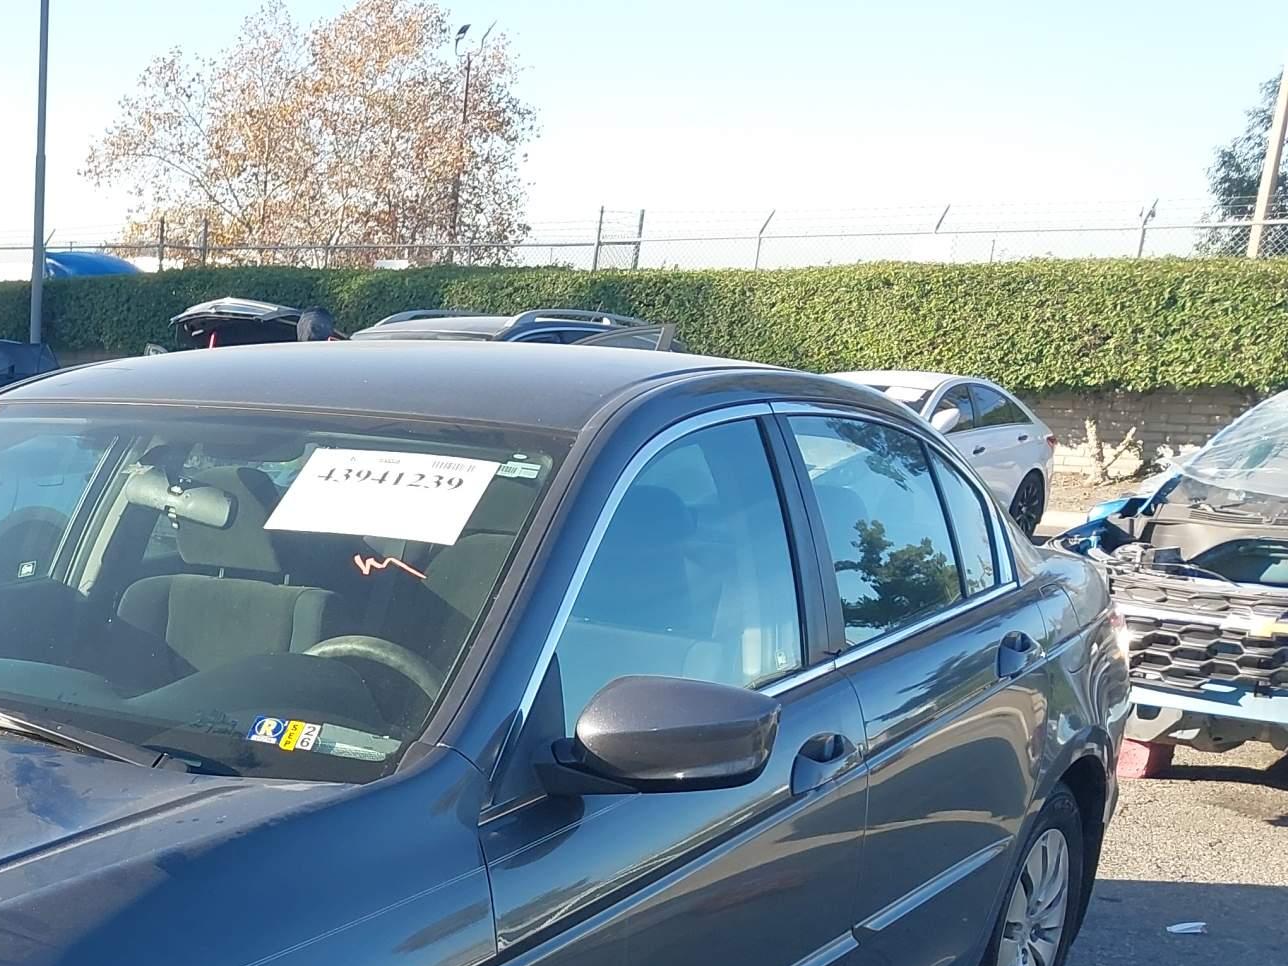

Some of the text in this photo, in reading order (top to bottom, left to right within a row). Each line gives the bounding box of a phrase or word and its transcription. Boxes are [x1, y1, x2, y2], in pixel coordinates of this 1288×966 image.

[317, 467, 464, 490] 43941239
[260, 718, 277, 736] R
[283, 723, 299, 747] SEP
[300, 726, 316, 748] 26
